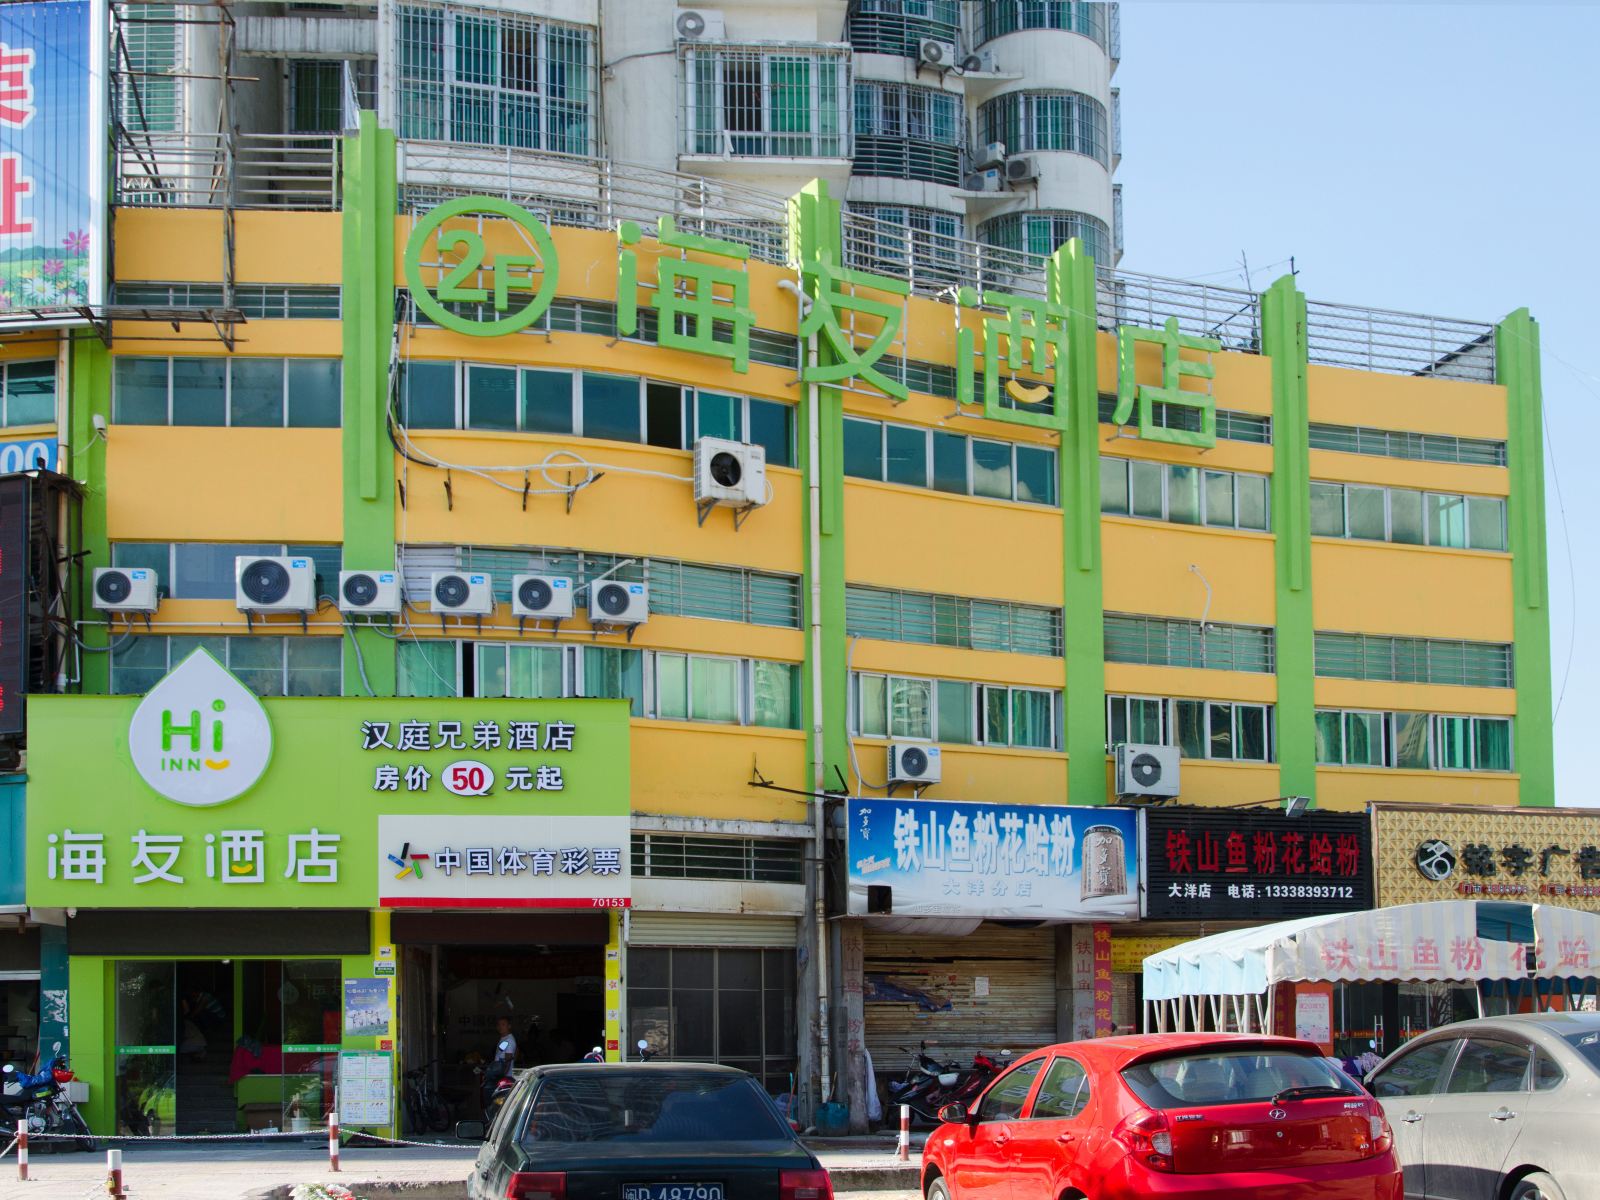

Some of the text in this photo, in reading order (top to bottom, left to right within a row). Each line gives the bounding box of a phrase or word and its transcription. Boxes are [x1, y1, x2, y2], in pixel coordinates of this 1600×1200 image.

[436, 214, 1222, 450] 2F 海友酒店
[161, 698, 226, 753] Hi
[360, 718, 577, 752] 汉庭兄弟酒店
[161, 757, 201, 772] INN
[452, 766, 485, 791] 50
[47, 828, 342, 885] 海友酒店
[893, 807, 1075, 877] 铁山鱼粉花蛤粉
[1164, 828, 1360, 877] 铁山鱼粉花蛤粉
[434, 846, 622, 877] 中国体育彩票
[591, 897, 626, 908] 70153
[943, 879, 1034, 898] 大洋分店
[1167, 882, 1212, 899] 大洋店
